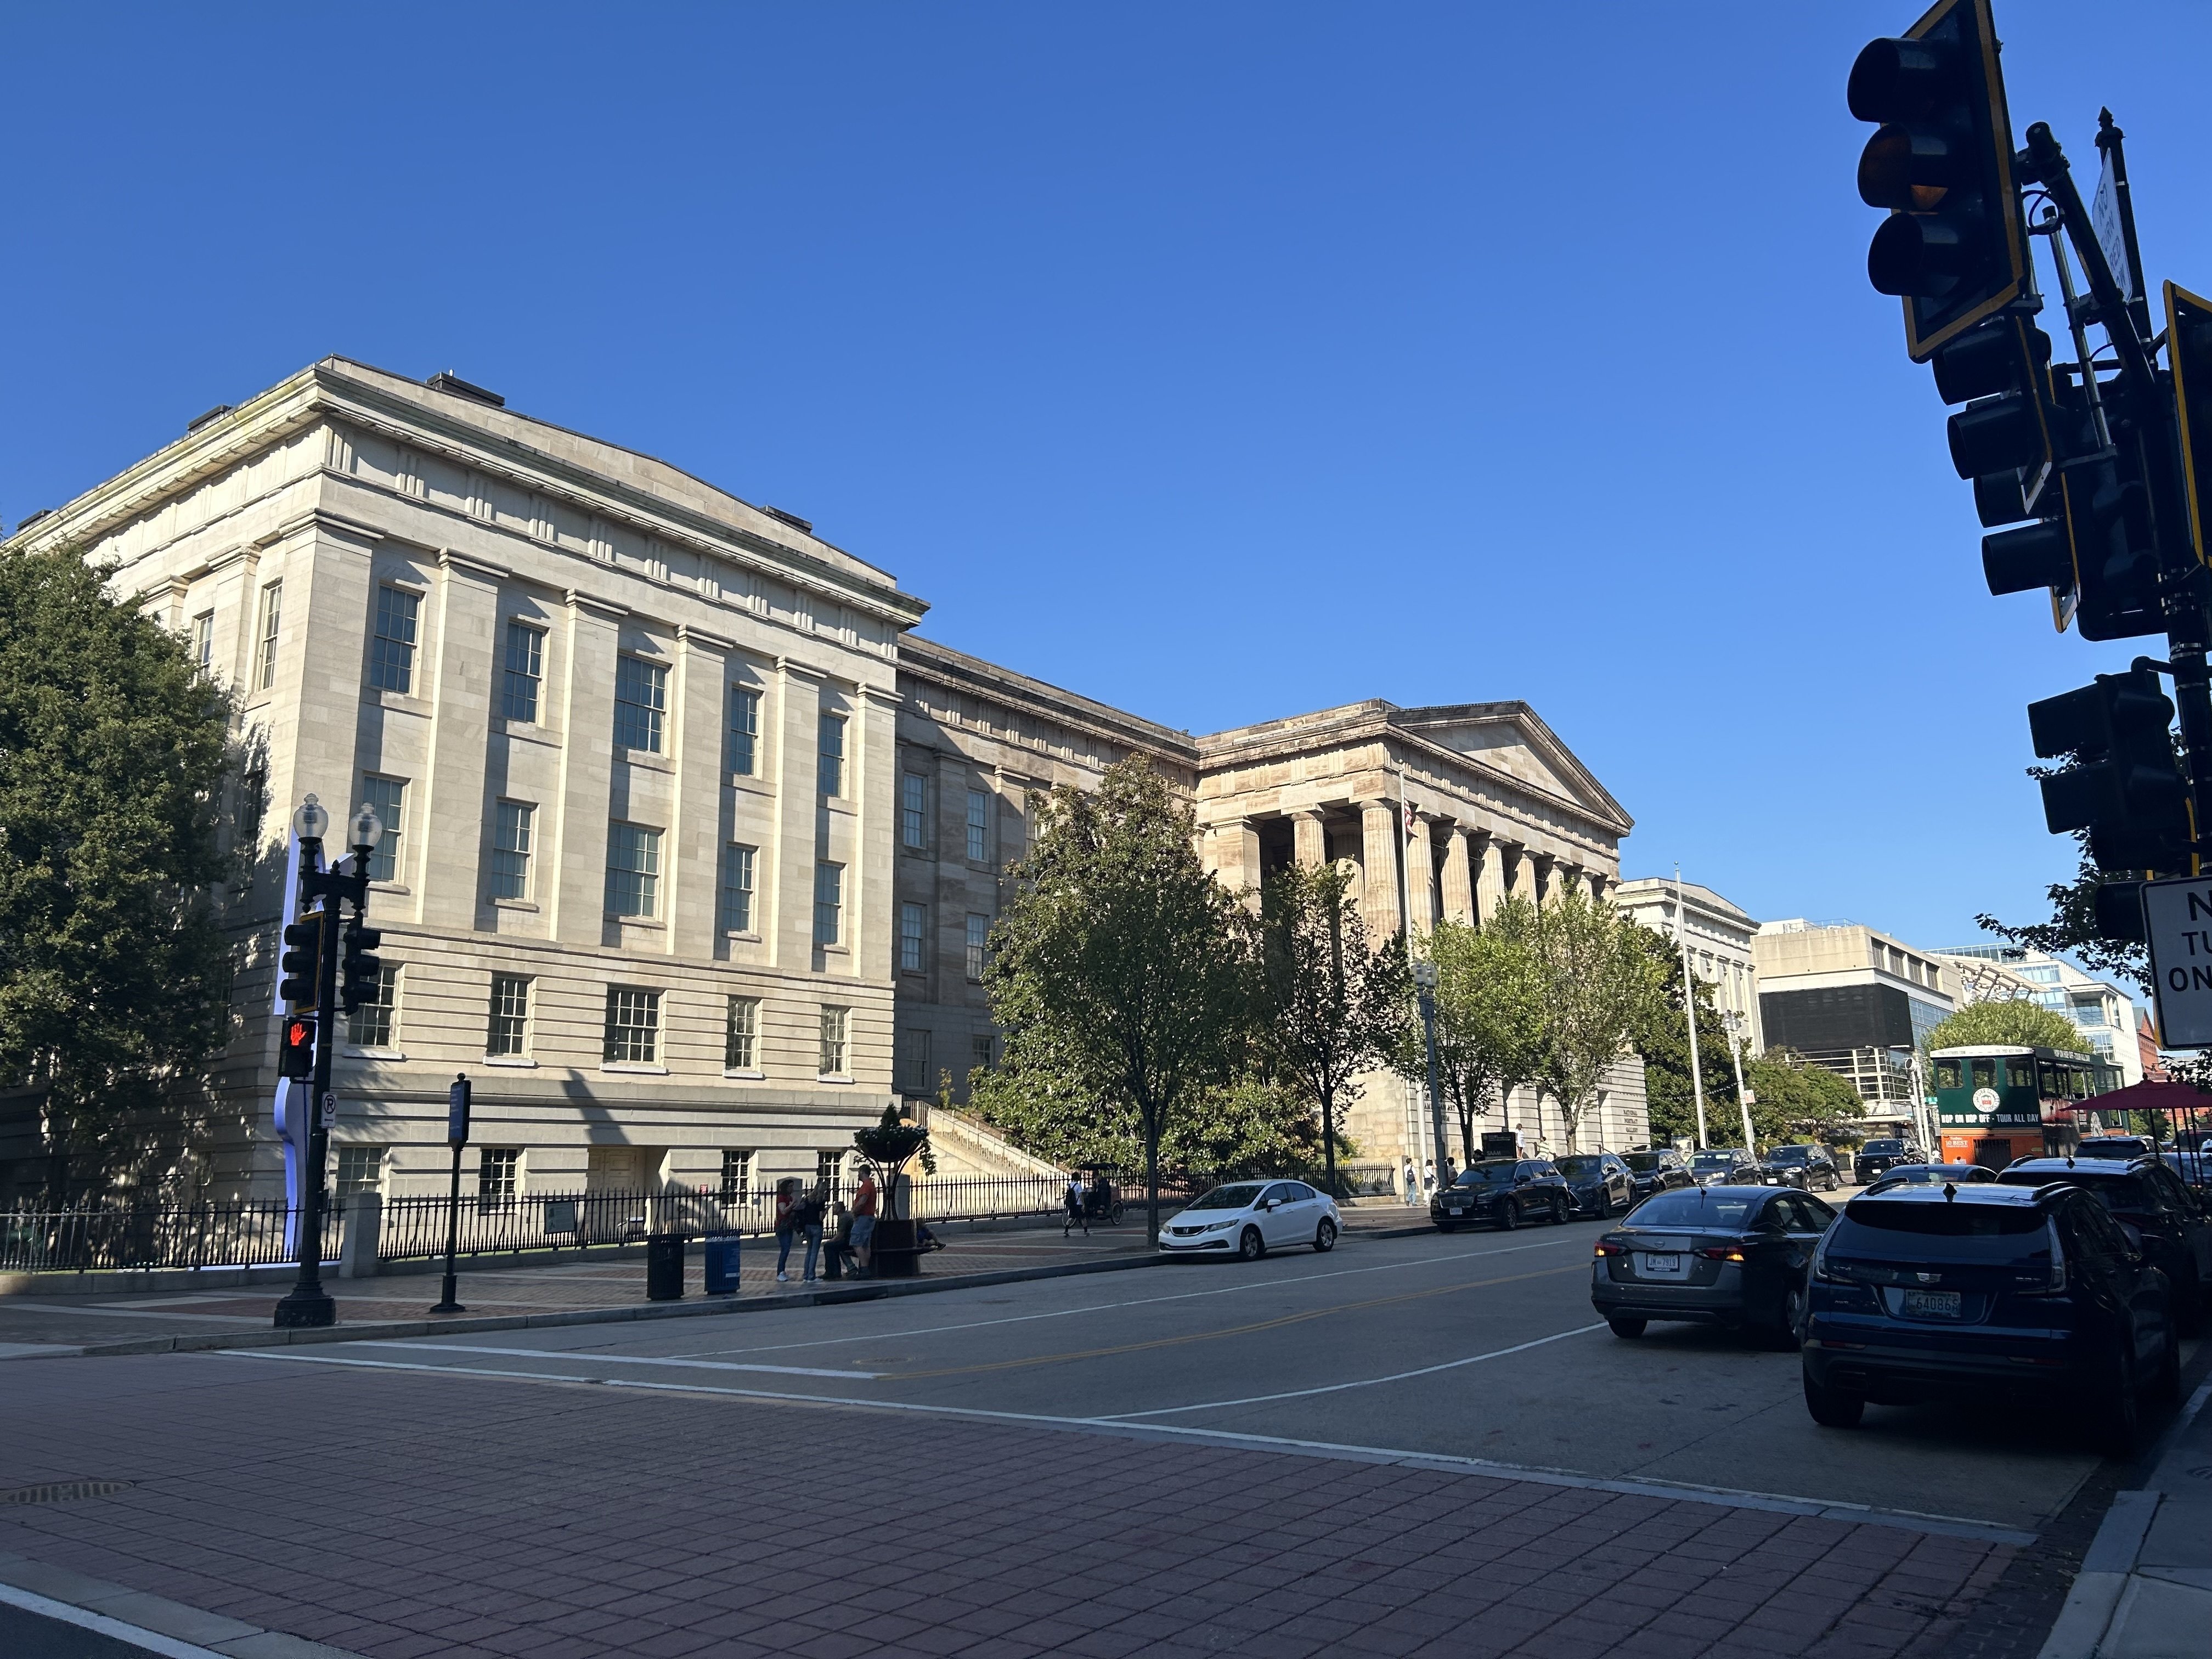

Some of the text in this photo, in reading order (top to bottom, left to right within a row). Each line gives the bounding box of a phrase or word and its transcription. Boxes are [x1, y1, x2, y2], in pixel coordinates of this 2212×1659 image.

[2187, 890, 2212, 921] N
[2181, 930, 2212, 956] TU
[1941, 1114, 1953, 1124] HOP
[1955, 1114, 1964, 1123] ON
[1965, 1114, 1977, 1123] HOP
[1979, 1114, 1990, 1123] OFF
[1996, 1114, 2012, 1122] TOUR
[2014, 1114, 2025, 1122] ALL
[2027, 1114, 2039, 1122] DAY
